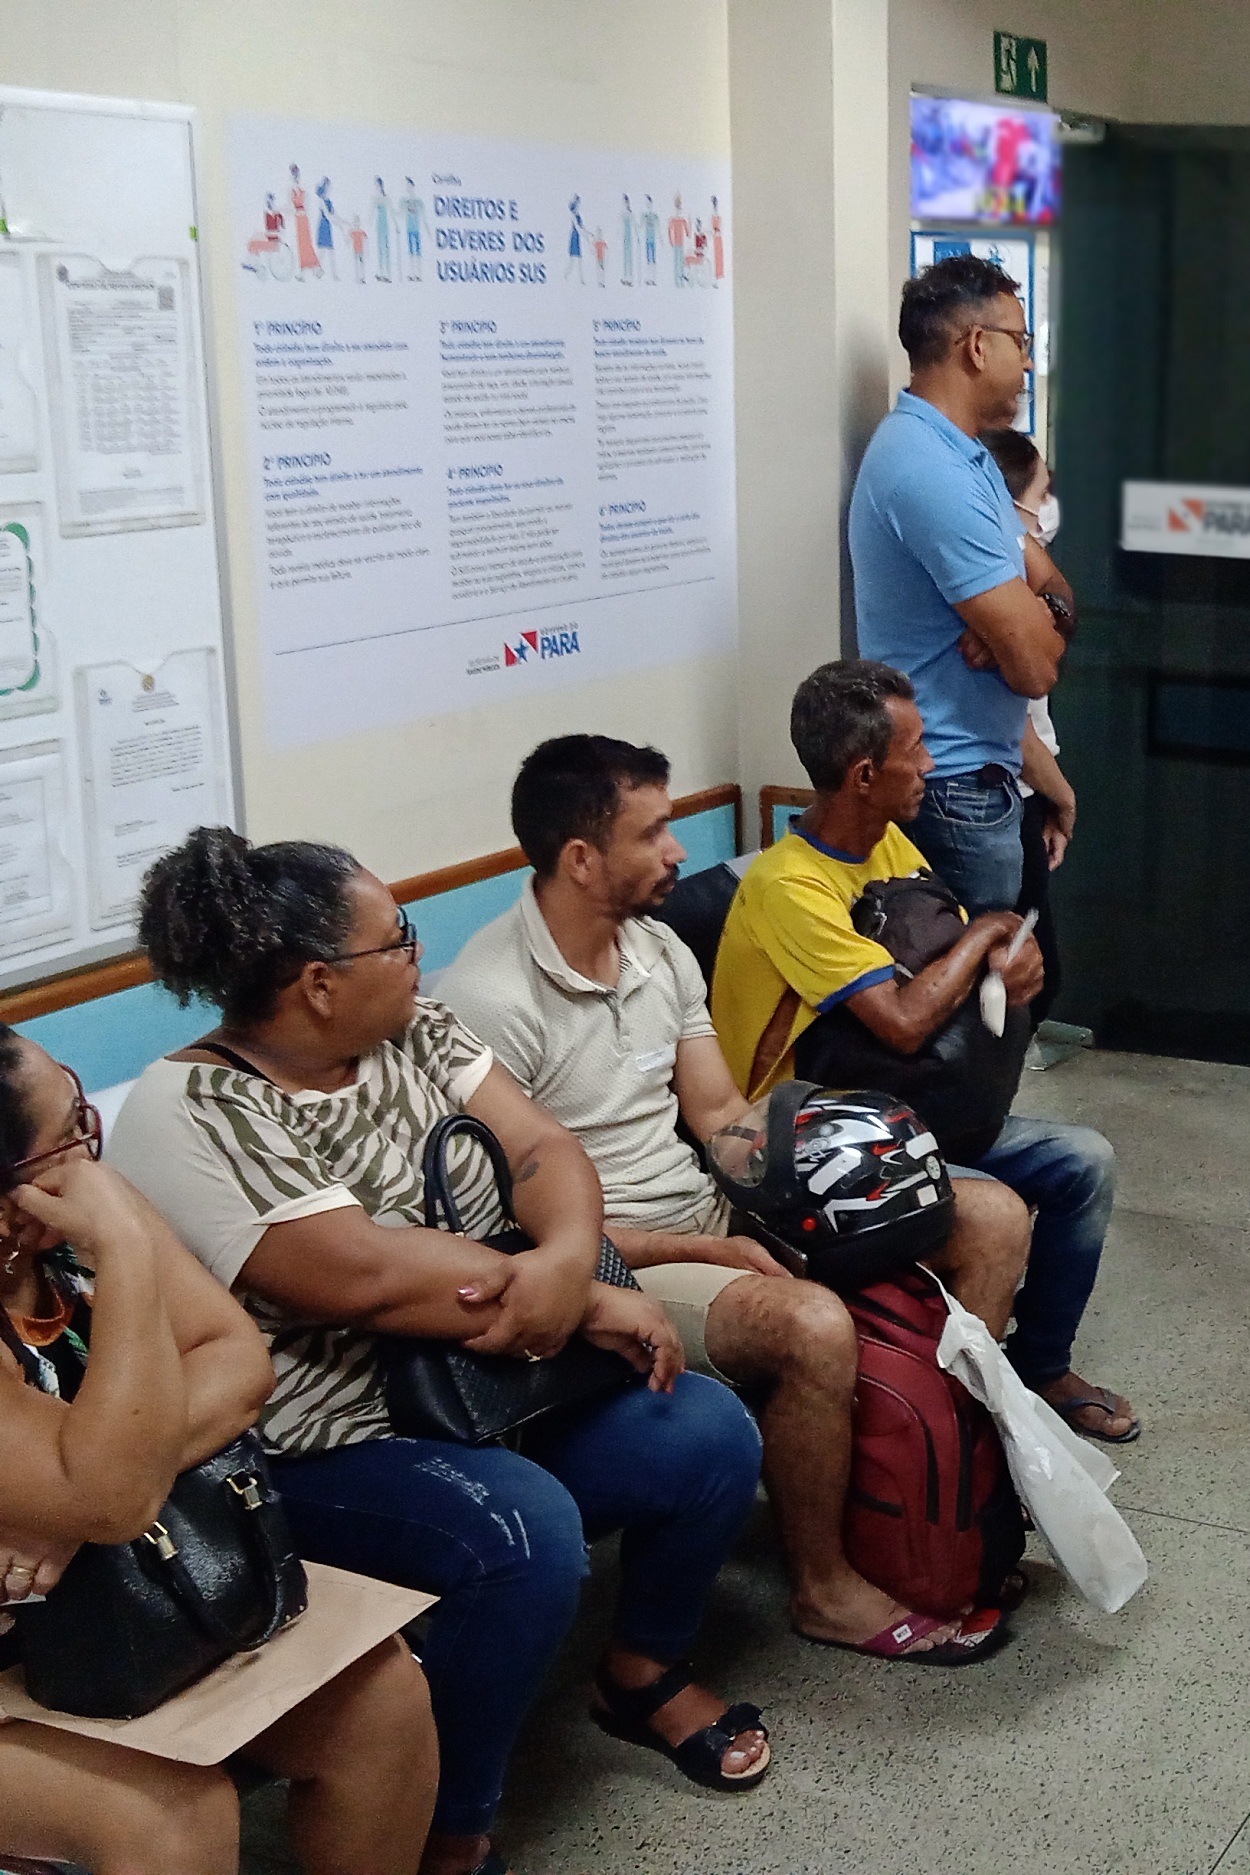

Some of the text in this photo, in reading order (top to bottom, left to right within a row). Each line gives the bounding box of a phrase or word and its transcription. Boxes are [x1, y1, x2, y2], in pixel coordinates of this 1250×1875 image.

[433, 195, 518, 221] DIREITOS E
[435, 228, 545, 253] DEVERES DOS
[436, 256, 548, 284] USUÁRIOS SUS
